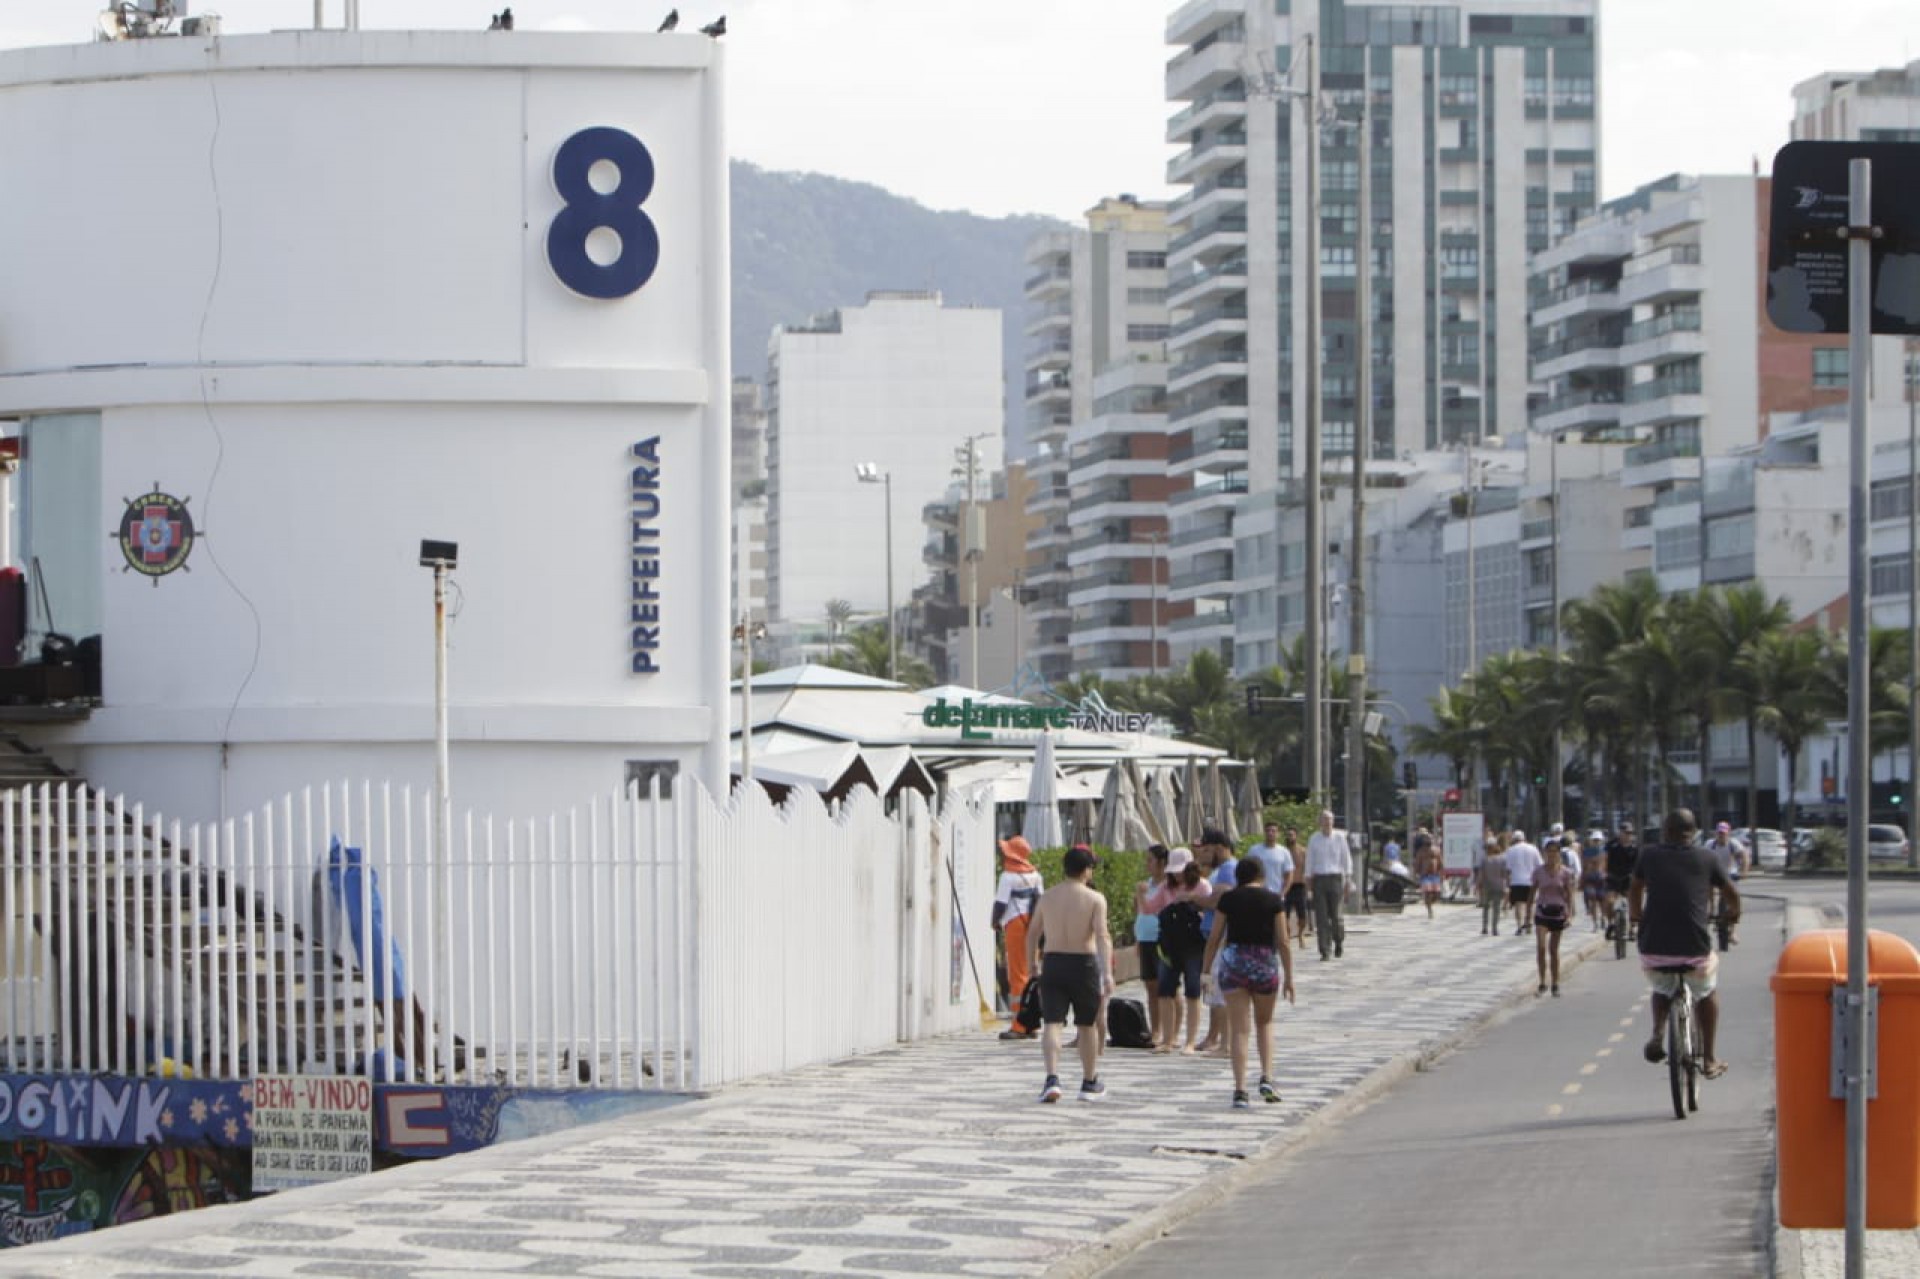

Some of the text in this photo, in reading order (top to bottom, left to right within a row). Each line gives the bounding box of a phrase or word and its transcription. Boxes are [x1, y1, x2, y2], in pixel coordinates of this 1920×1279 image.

[546, 126, 660, 299] 8
[631, 435, 661, 674] PREFEITURA
[255, 1078, 370, 1111] BEM-VINDO
[266, 1111, 295, 1129] PRAIA
[302, 1112, 315, 1129] DE
[319, 1112, 368, 1130] IPANEMA
[312, 1132, 339, 1150] PRAIA
[345, 1156, 369, 1173] LIXO
